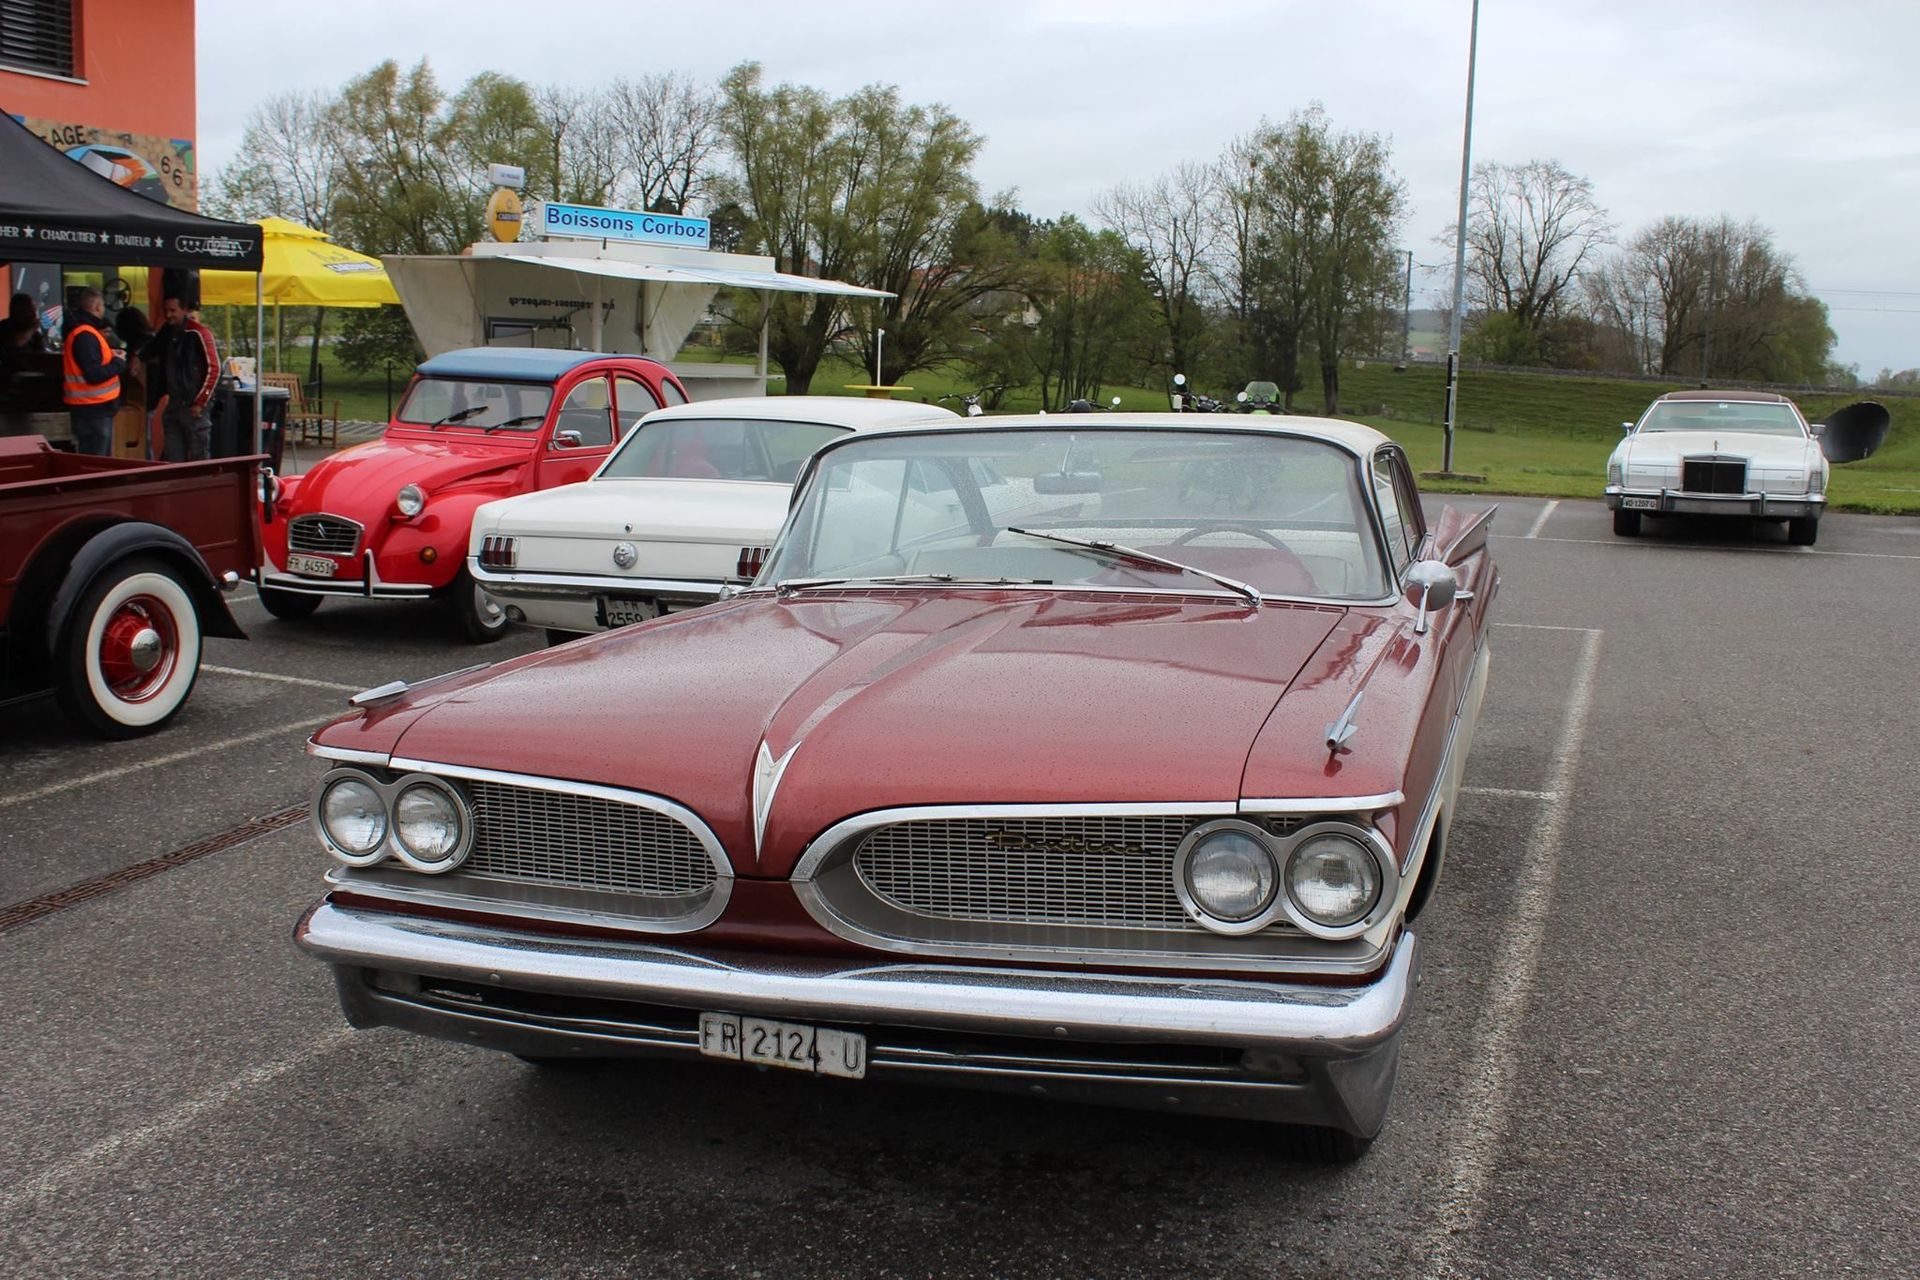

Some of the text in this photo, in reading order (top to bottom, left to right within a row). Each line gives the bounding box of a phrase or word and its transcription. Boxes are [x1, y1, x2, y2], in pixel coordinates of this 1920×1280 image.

[41, 125, 87, 146] AGE
[547, 207, 706, 239] Boissons Corboz
[40, 229, 97, 244] CHARCUTIER
[114, 234, 151, 247] TRAITEUR
[304, 560, 329, 574] 64551
[703, 1020, 861, 1071] FR 2124 U
